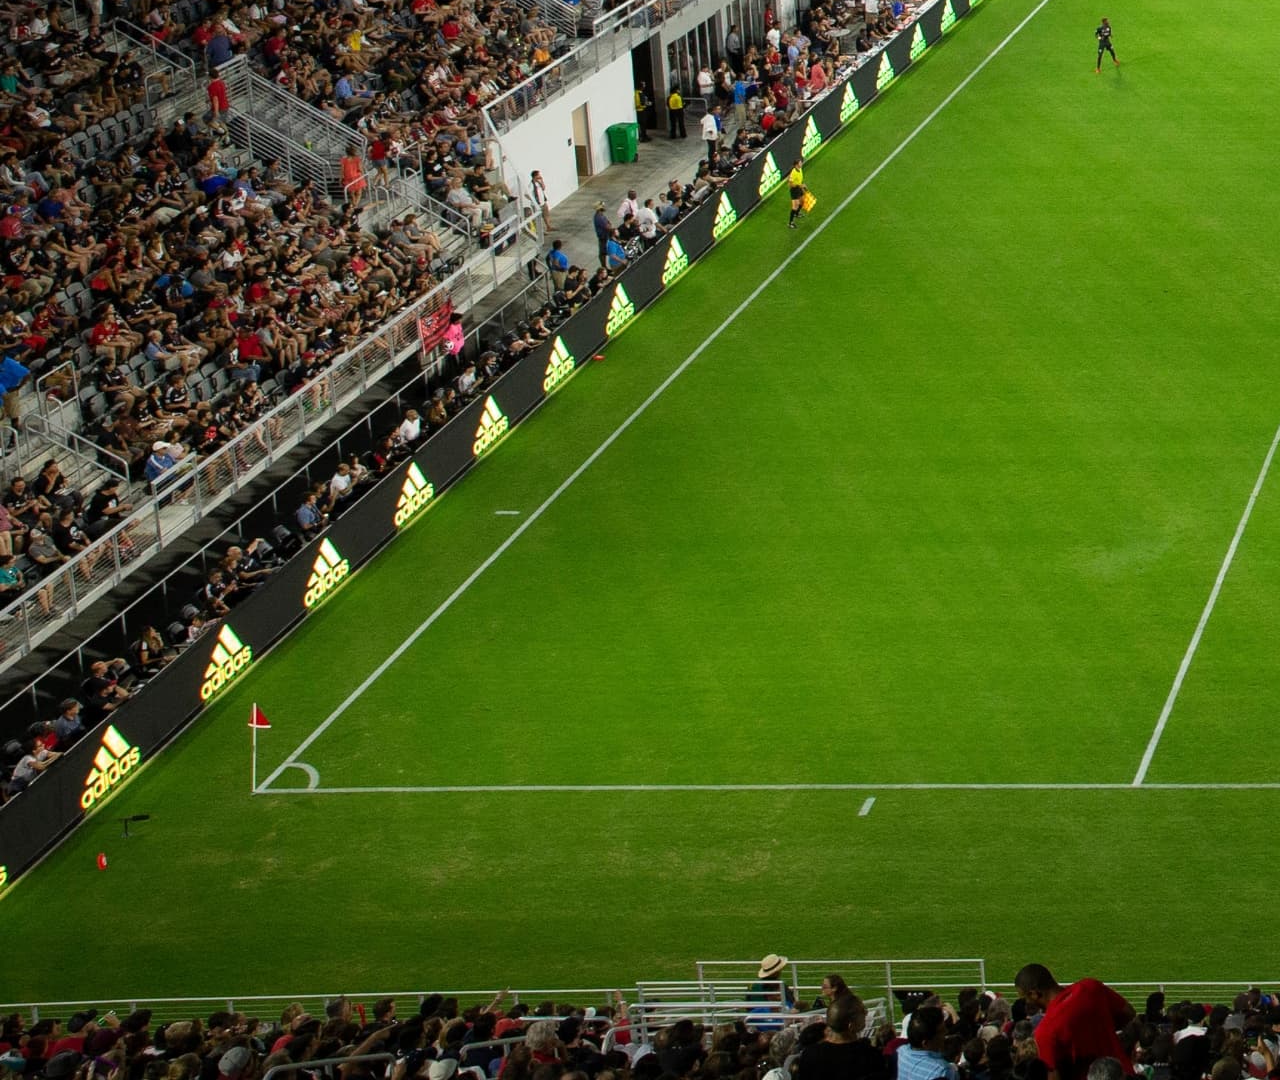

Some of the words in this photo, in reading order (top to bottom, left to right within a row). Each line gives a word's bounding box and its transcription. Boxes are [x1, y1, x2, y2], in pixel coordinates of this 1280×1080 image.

[544, 356, 575, 392] adidas
[473, 415, 509, 456] adidas
[395, 483, 434, 526] adidas
[304, 559, 349, 608] adidas
[201, 646, 252, 700] adidas
[81, 746, 140, 809] adidas
